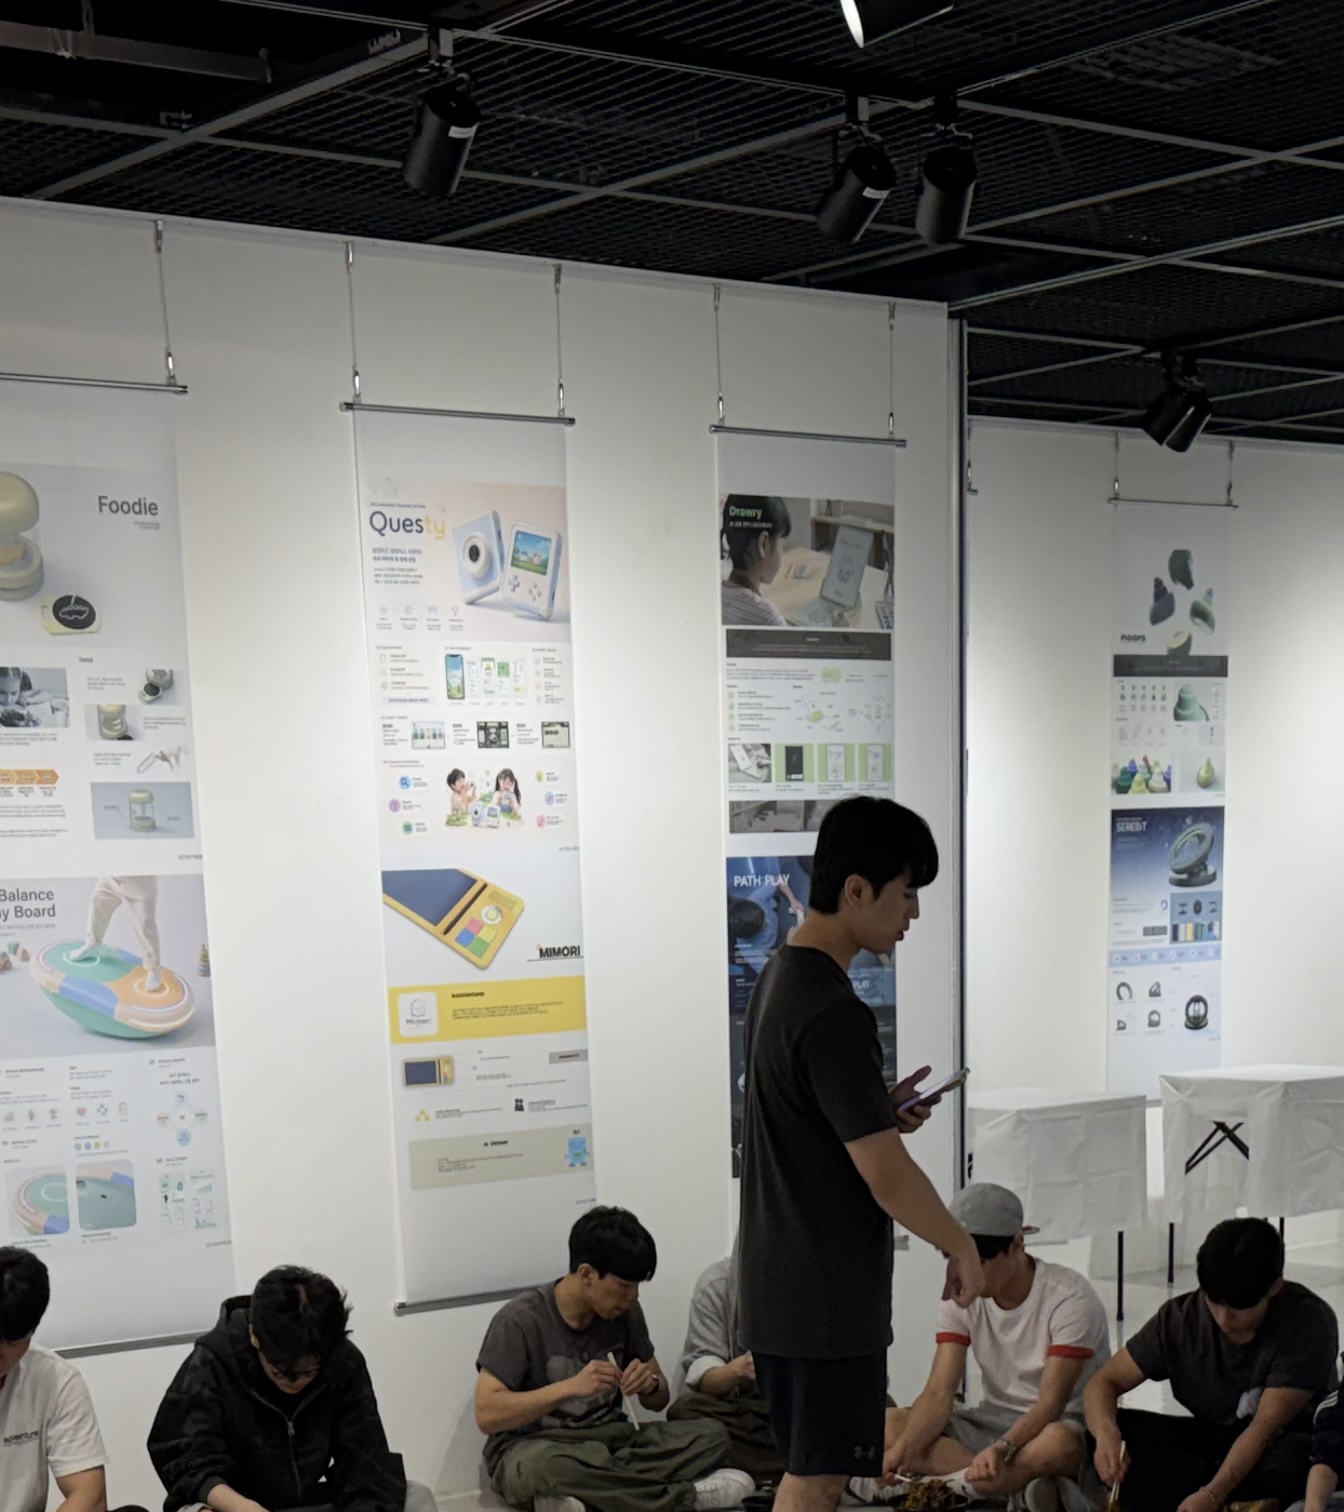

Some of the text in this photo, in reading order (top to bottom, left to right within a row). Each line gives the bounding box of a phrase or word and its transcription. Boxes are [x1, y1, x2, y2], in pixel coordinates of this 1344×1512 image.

[98, 495, 159, 517] Foodie
[14, 903, 56, 919] Board
[538, 944, 582, 959] MIMORI
